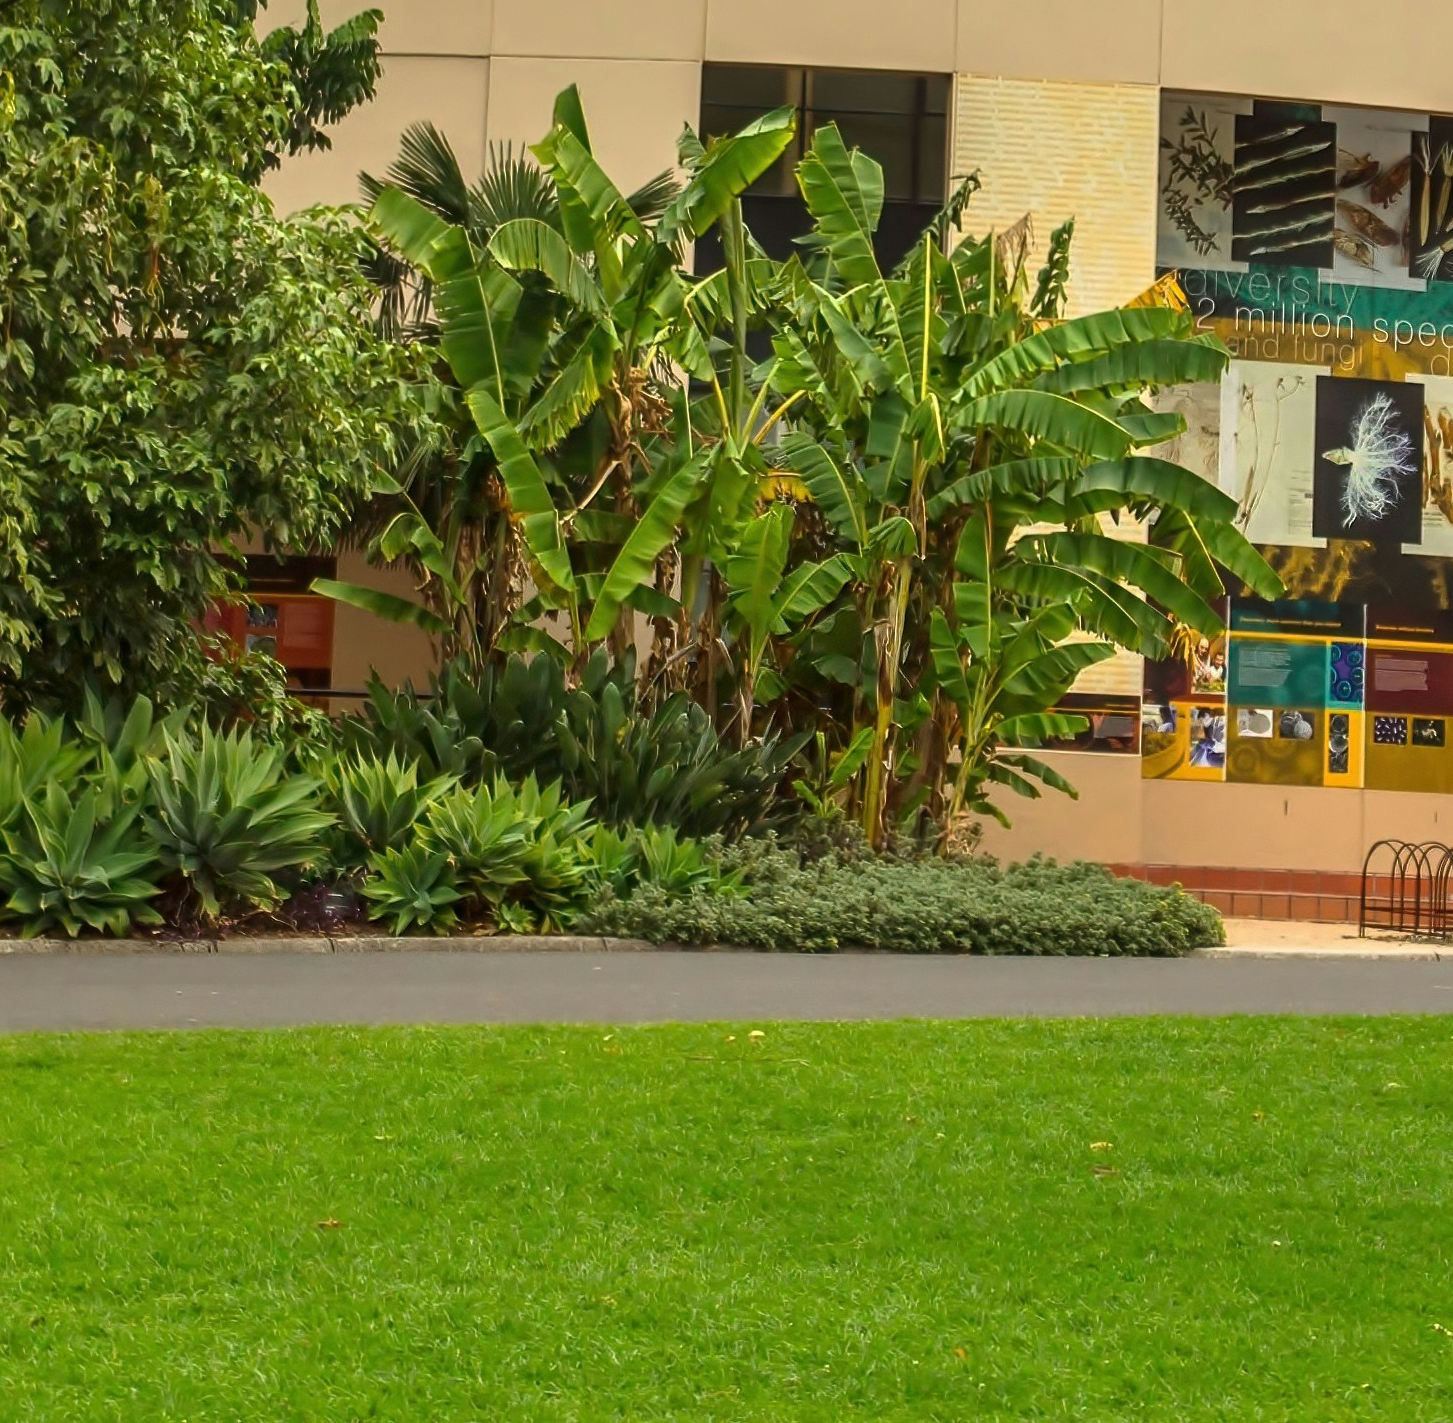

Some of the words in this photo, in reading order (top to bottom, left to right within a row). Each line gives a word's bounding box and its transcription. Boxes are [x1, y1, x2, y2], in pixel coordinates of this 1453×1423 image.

[1196, 297, 1216, 330] 2
[1235, 301, 1354, 341] million
[1224, 332, 1280, 360] and
[1293, 332, 1364, 371] fungi
